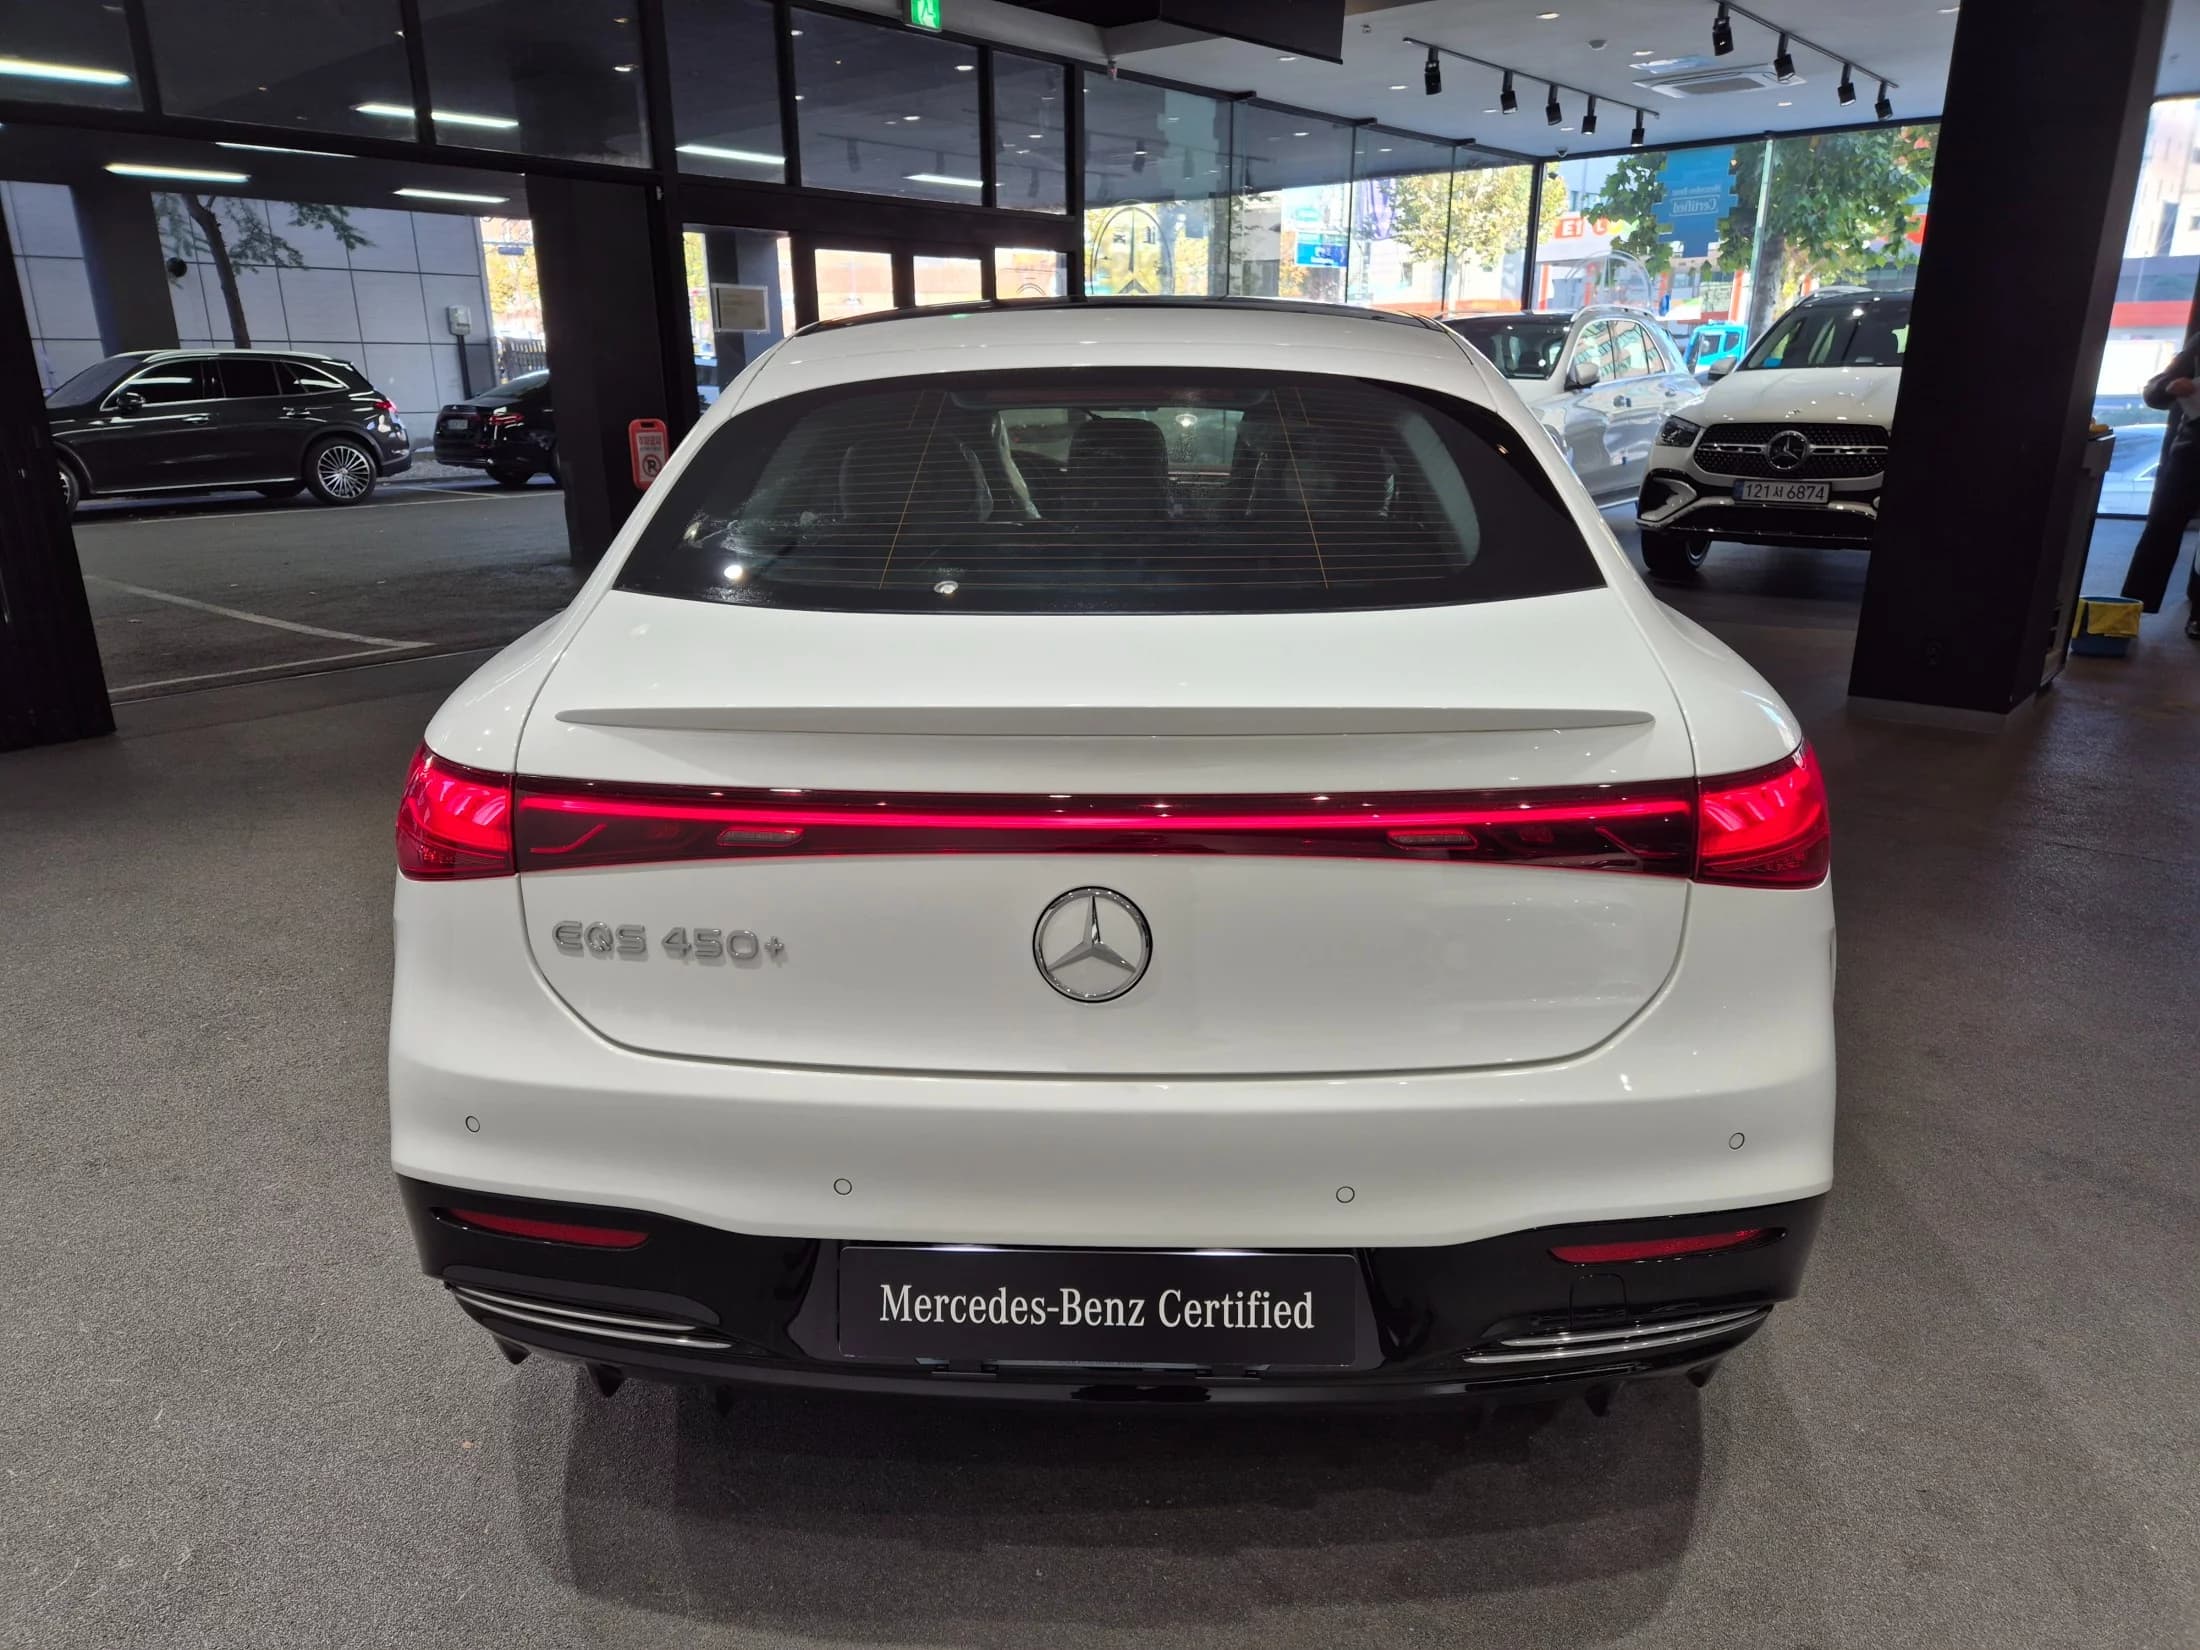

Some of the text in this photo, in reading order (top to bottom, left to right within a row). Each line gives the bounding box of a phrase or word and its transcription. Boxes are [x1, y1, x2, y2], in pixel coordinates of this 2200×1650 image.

[552, 920, 785, 961] EQS 450+
[880, 1284, 1314, 1329] Mercedes-Benz Certified
